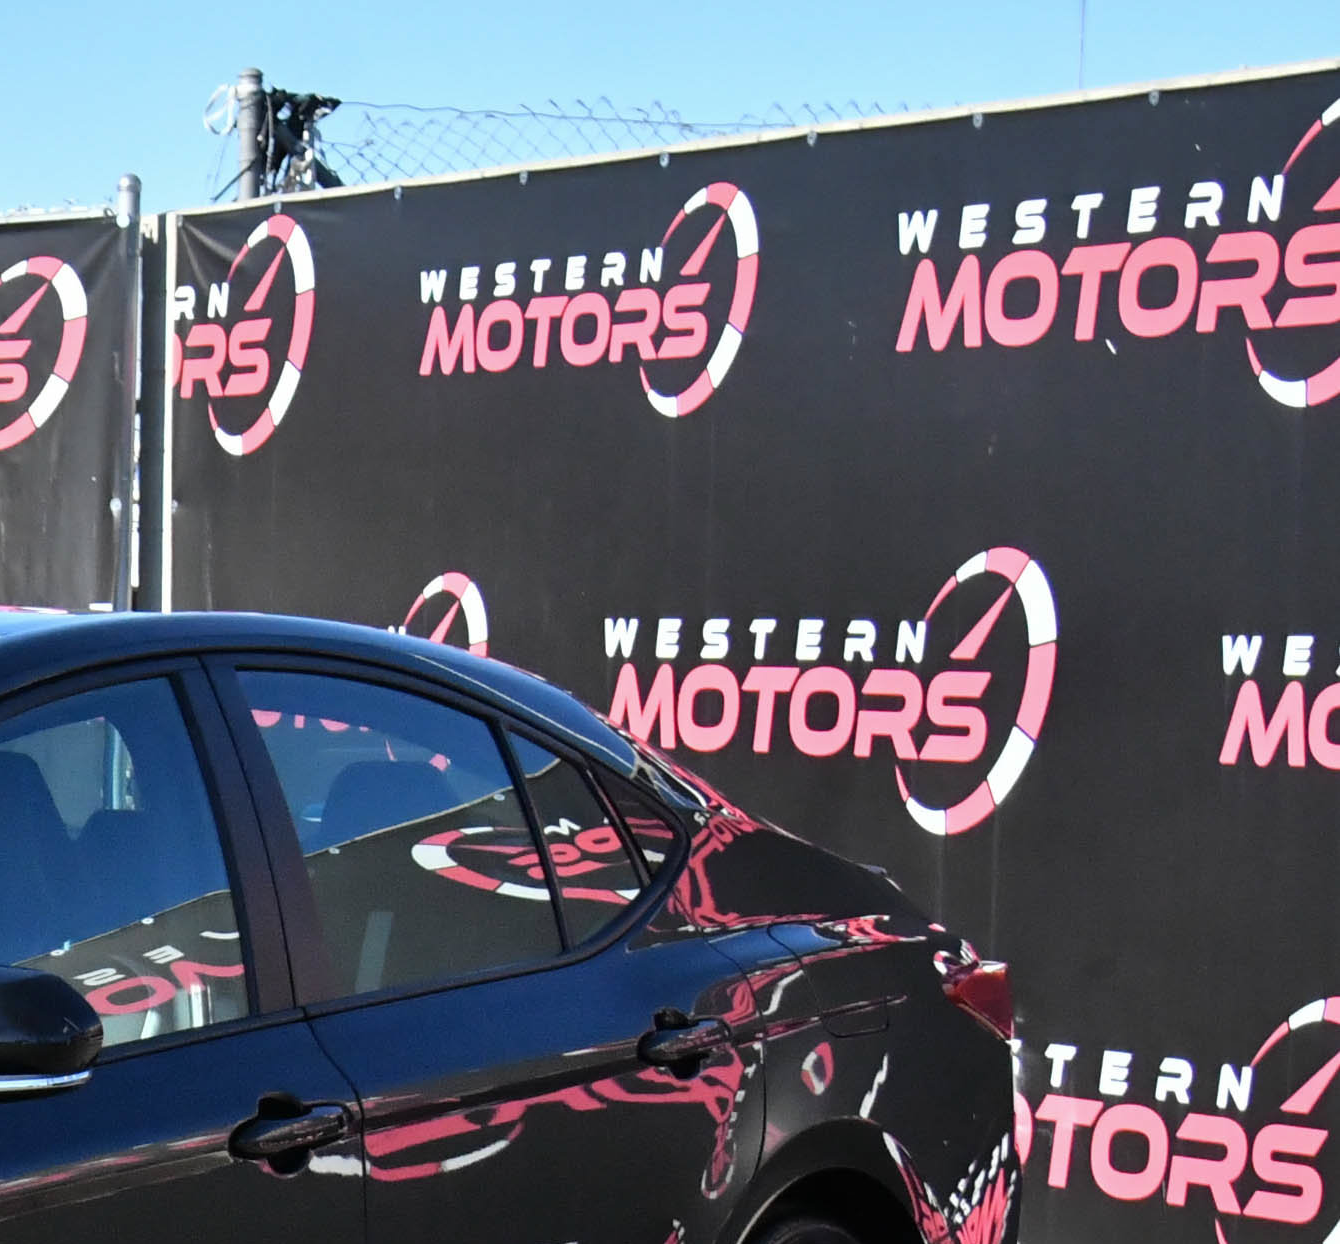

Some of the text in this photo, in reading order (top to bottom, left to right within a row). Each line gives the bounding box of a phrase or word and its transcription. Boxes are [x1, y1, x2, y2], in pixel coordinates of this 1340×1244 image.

[898, 174, 1284, 255] WESTERN
[420, 247, 663, 304] WESTERN
[895, 222, 1340, 352] MOTORS
[172, 318, 272, 399] RS
[419, 283, 711, 376] MOTORS
[604, 618, 927, 663] WESTERN
[1222, 634, 1340, 676] WE
[609, 663, 991, 763] MOTORS
[1014, 1092, 1329, 1224] TORS
